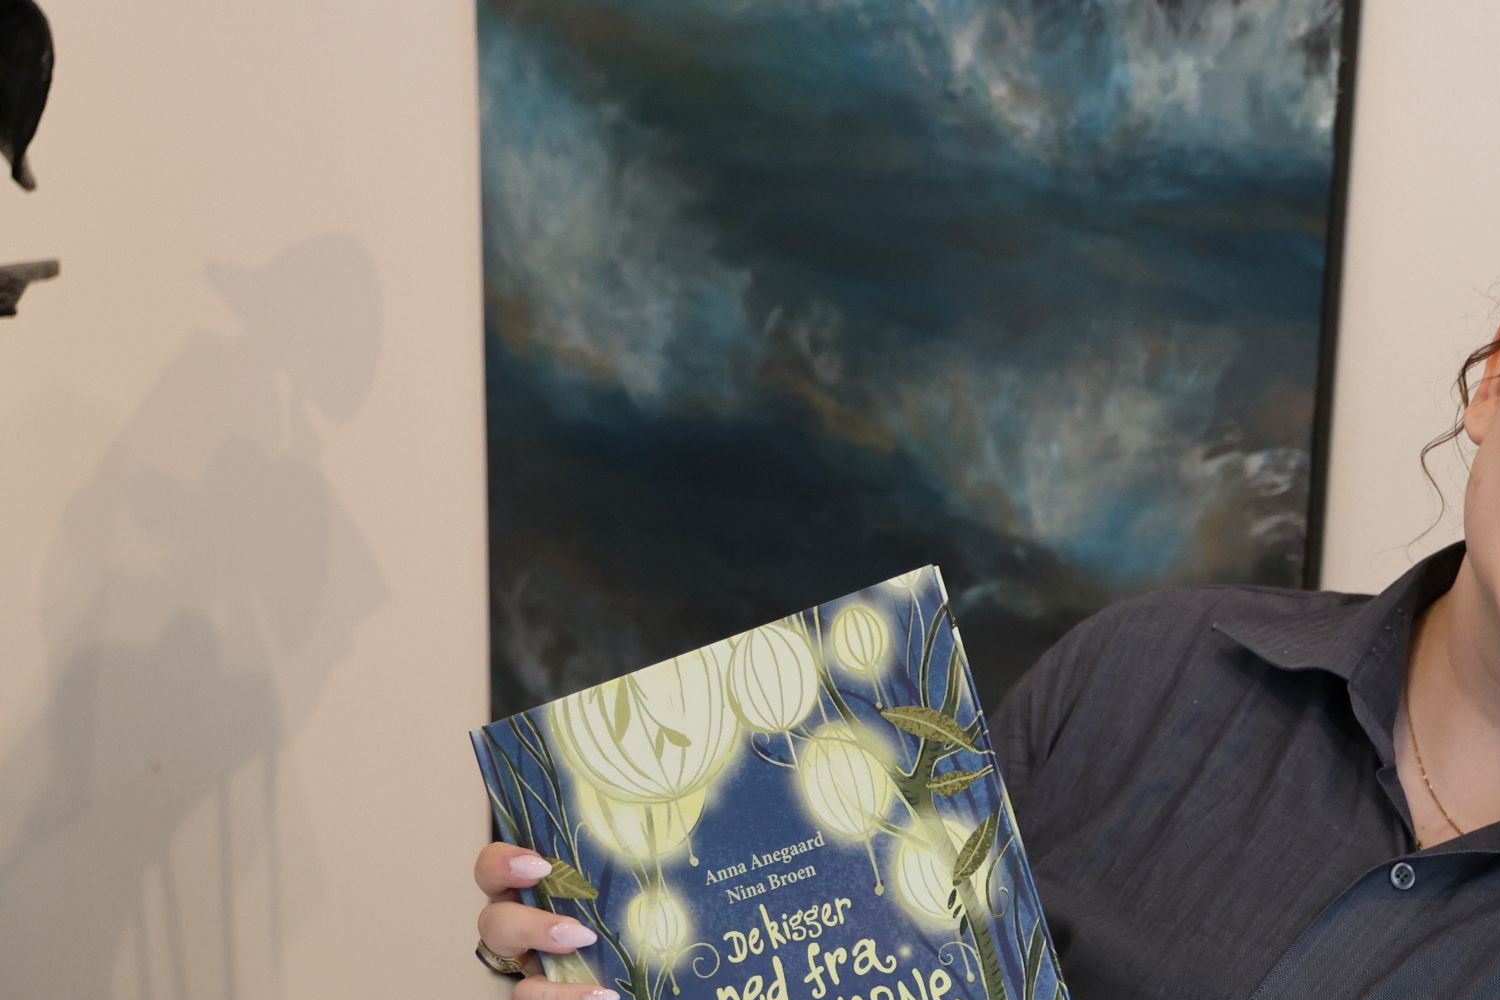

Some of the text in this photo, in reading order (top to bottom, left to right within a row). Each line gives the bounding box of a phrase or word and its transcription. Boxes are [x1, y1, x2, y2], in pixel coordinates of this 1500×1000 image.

[705, 830, 826, 886] Anna Anegaard
[725, 865, 817, 905] Nina Broen
[723, 897, 852, 963] De kigger
[804, 938, 897, 999] fra
